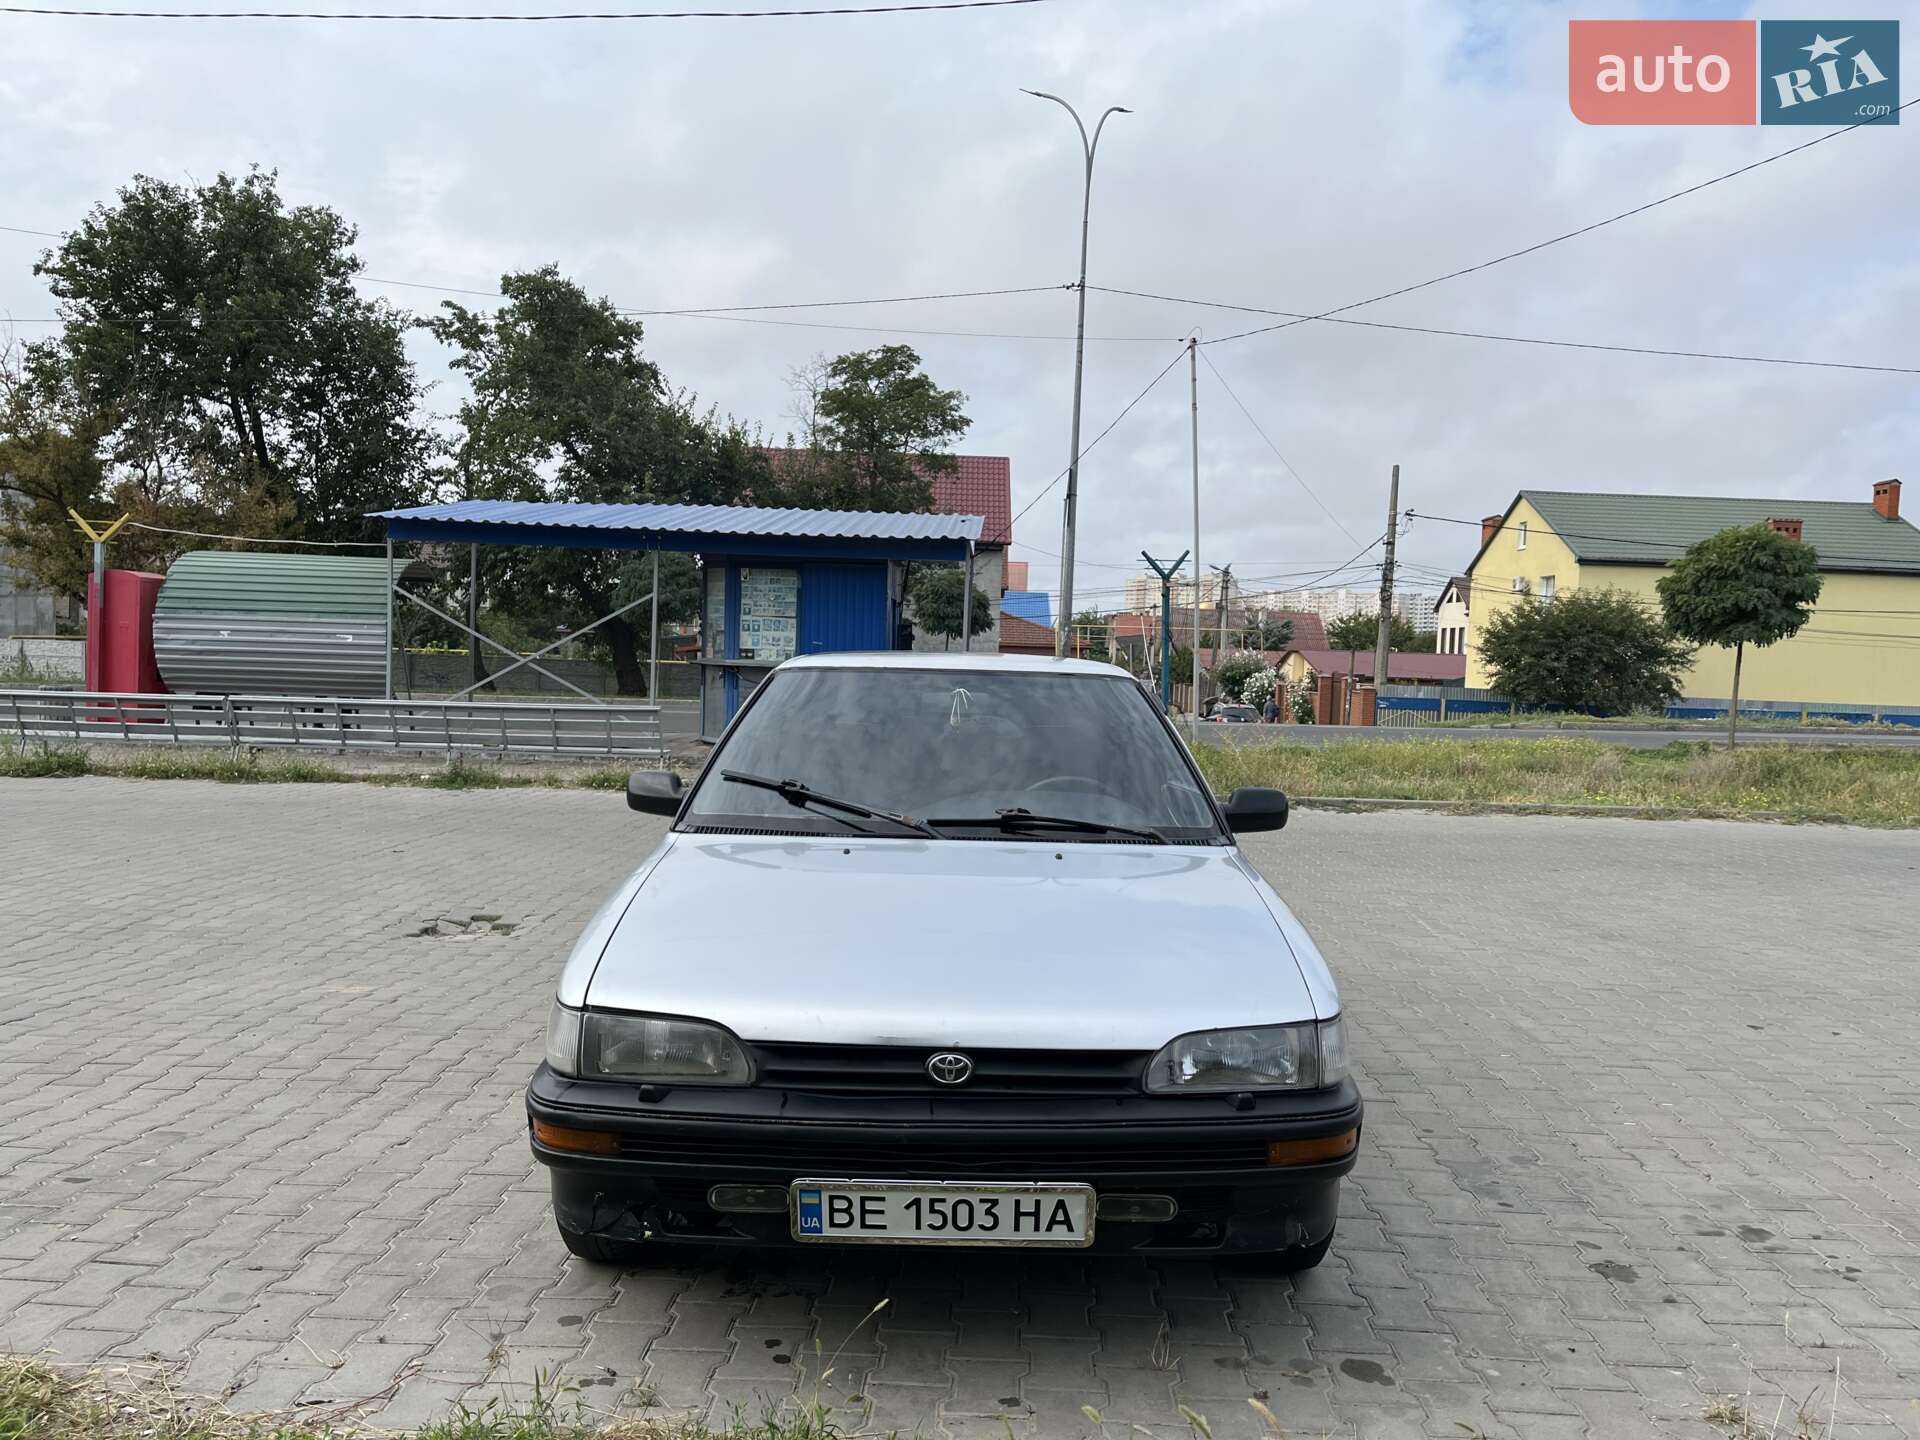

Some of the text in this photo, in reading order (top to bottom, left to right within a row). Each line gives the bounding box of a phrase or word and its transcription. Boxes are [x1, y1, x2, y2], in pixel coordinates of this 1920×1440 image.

[801, 1216, 821, 1229] UA
[828, 1194, 1075, 1233] BE 1503 HA
